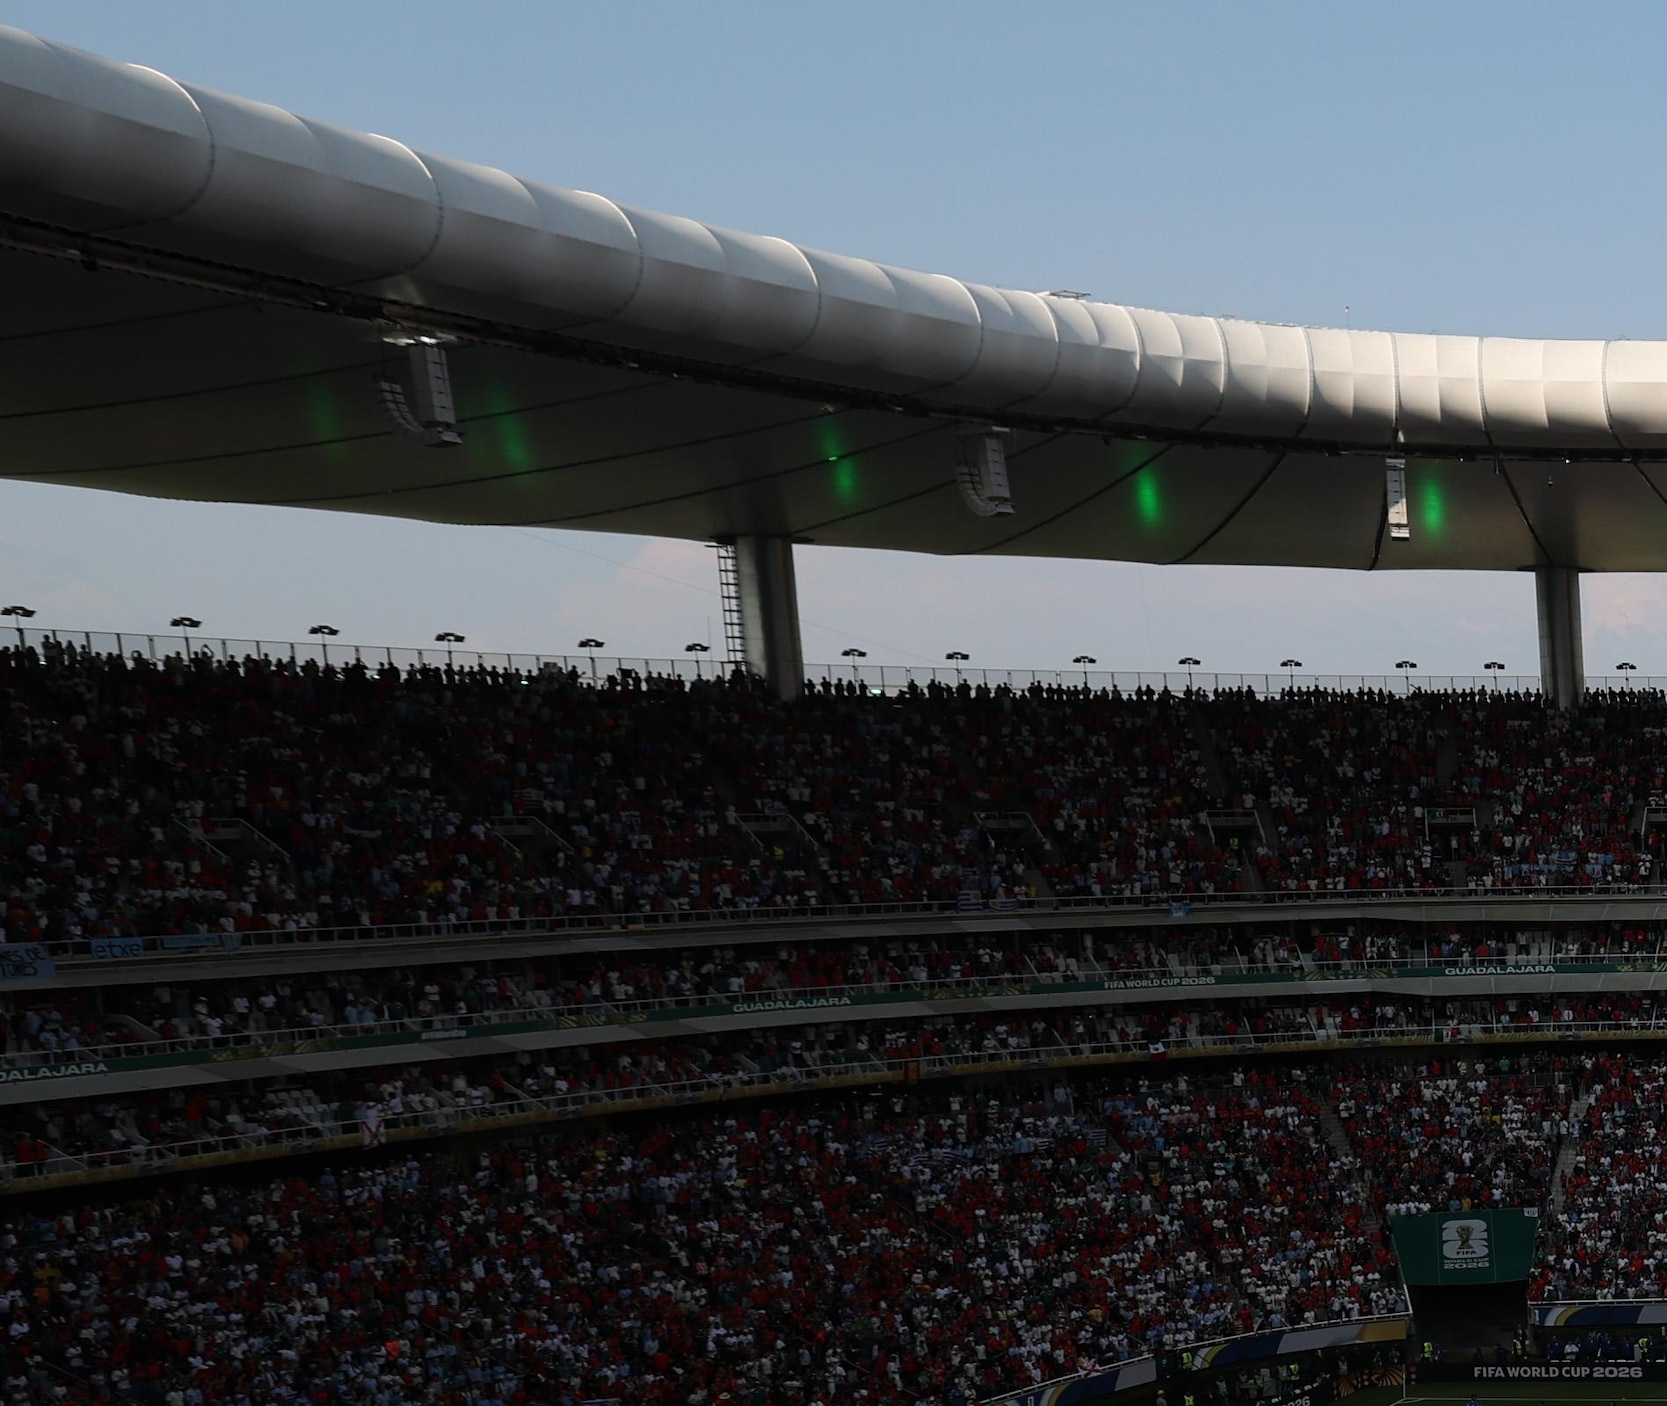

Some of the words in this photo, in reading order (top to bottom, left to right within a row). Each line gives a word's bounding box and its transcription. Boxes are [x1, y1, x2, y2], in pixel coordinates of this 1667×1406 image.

[95, 943, 141, 959] etxe
[1444, 965, 1555, 975] GUADALAJARA
[1104, 980, 1125, 989] FIFA
[1127, 978, 1160, 988] WORLD
[1161, 977, 1180, 986] CUP
[1181, 976, 1215, 985] 2026
[733, 997, 851, 1013] GUADALAJARA
[1474, 1366, 1505, 1378] FIFA
[1506, 1366, 1559, 1378] WORLD
[1561, 1366, 1590, 1378] CUP
[1592, 1366, 1643, 1378] 2026
